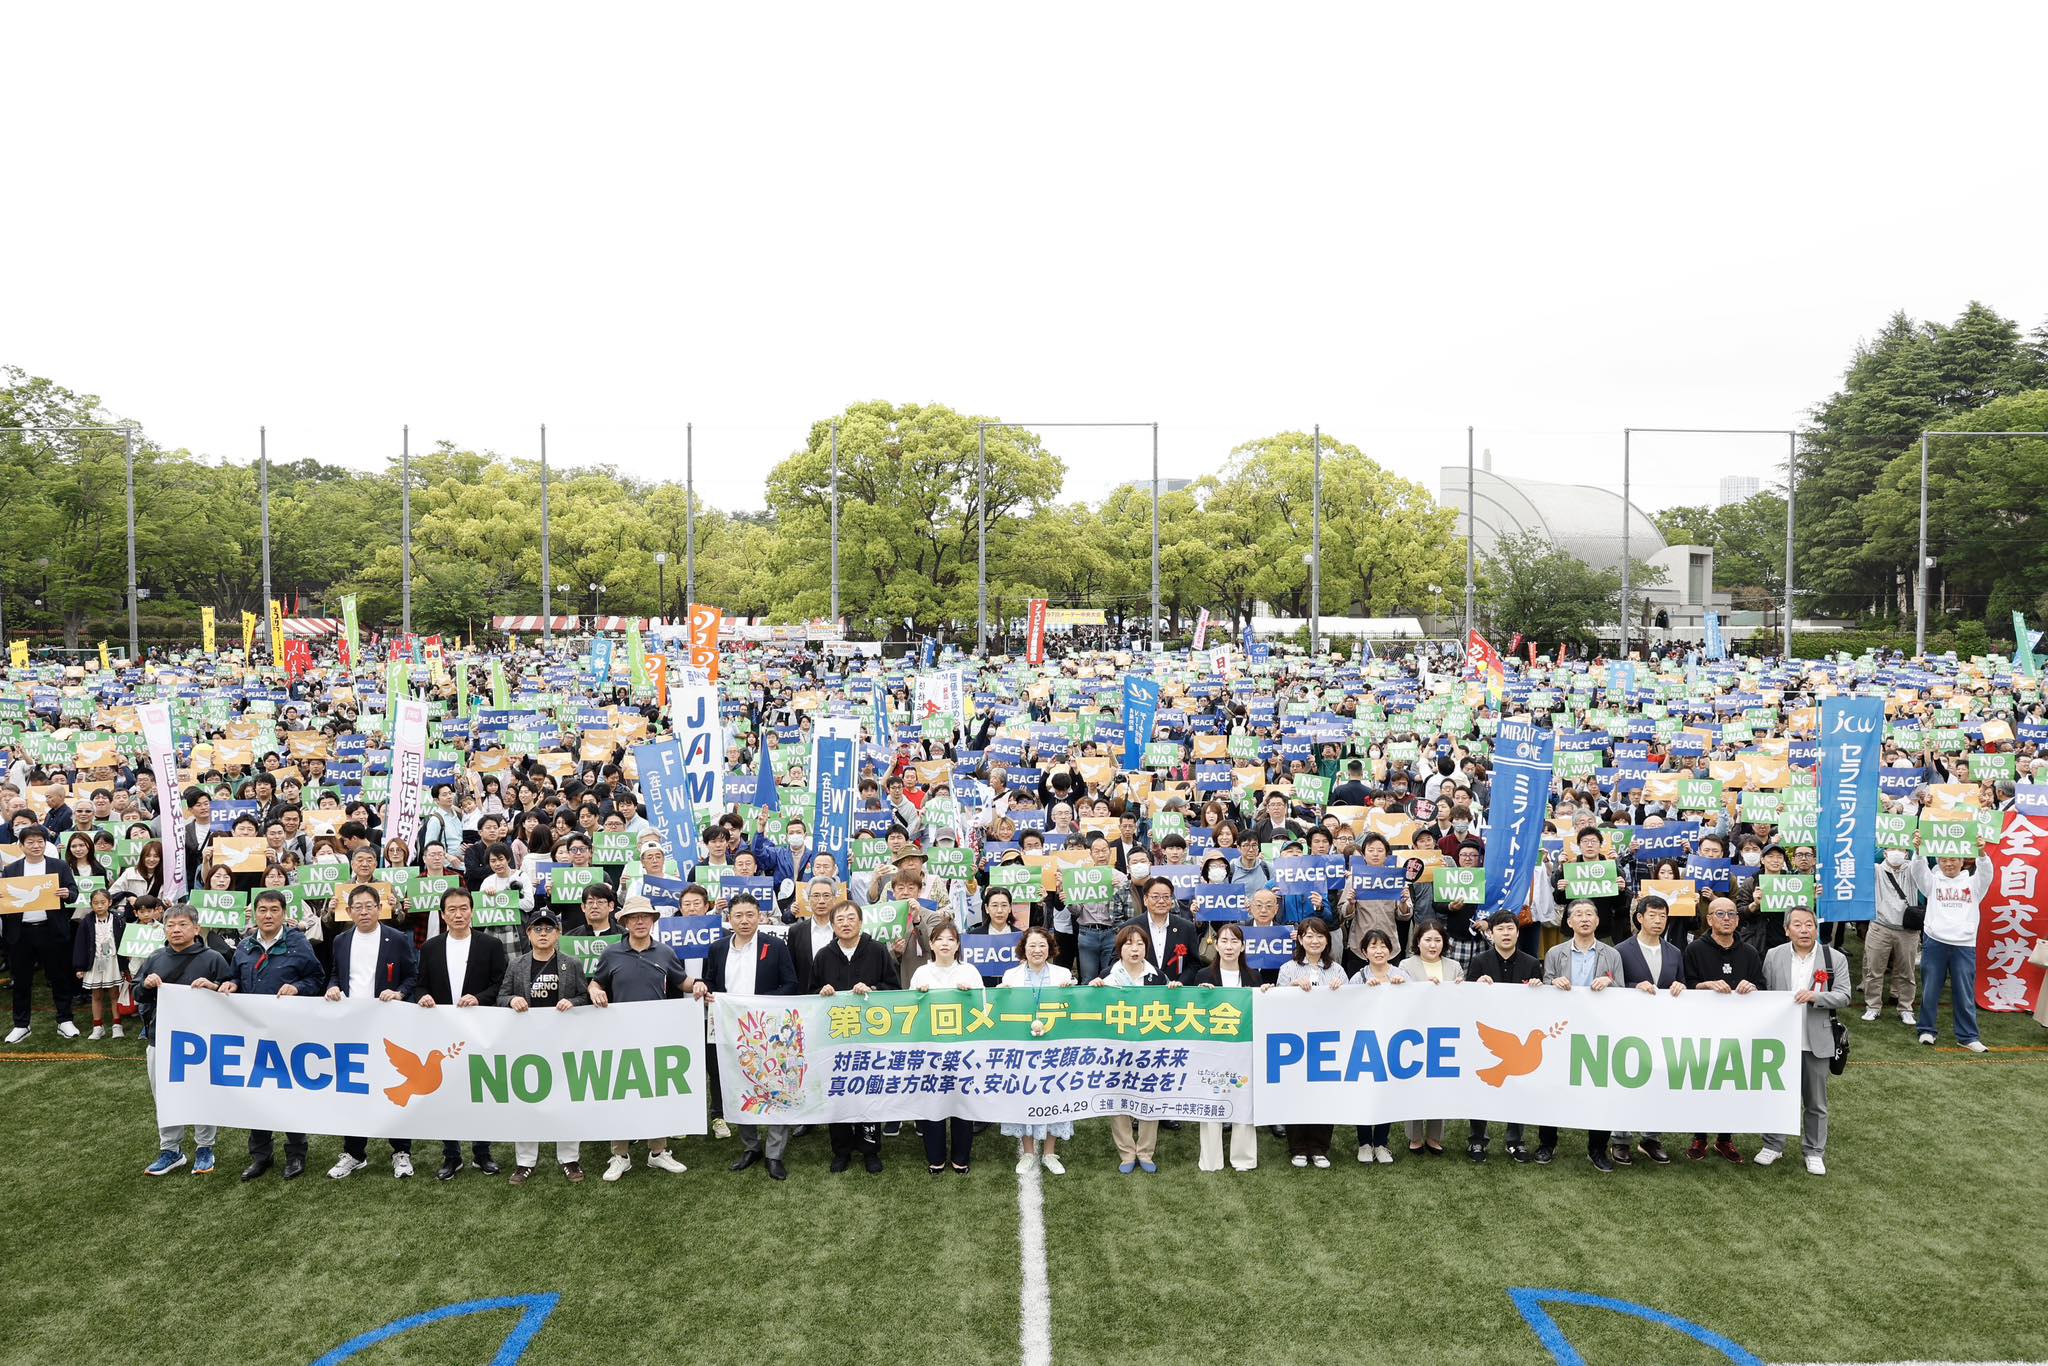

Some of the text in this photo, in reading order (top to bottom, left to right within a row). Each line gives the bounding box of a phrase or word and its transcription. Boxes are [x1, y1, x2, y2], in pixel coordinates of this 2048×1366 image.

[67, 701, 83, 709] NO
[479, 715, 507, 724] PEACE
[580, 715, 607, 724] PEACE
[1157, 712, 1182, 721] PEACE
[1191, 718, 1214, 727] PEACE
[1251, 714, 1273, 722] PEACE
[1751, 718, 1774, 727] WAR
[443, 723, 468, 733] PEACE
[929, 719, 944, 729] NO
[1390, 722, 1411, 731] WAR
[1629, 725, 1655, 734] PEACE
[1729, 723, 1745, 731] NO
[80, 733, 96, 741] NO
[514, 733, 532, 742] NO
[899, 731, 921, 739] PEACE
[926, 729, 948, 738] WAR
[1095, 726, 1124, 738] PEACE
[1318, 729, 1346, 738] PEACE
[1501, 722, 1536, 742] MIRAIT
[1725, 732, 1749, 740] WAR
[1901, 731, 1918, 740] NO
[1937, 731, 1958, 740] NO
[2017, 727, 2047, 738] PEACE
[109, 735, 129, 744] NO
[336, 739, 365, 749] PEACE
[1235, 737, 1252, 748] NO
[1465, 741, 1481, 750] NO
[1561, 741, 1590, 750] PEACE
[1671, 740, 1702, 749] PEACE
[1900, 741, 1920, 750] WAR
[1933, 740, 1960, 749] WAR
[48, 742, 68, 751] NO
[509, 743, 535, 752] WAR
[684, 696, 715, 804] JAM
[787, 745, 806, 755] NO
[992, 744, 1020, 756] PEACE
[1038, 742, 1067, 754] PEACE
[1152, 746, 1171, 754] NO
[1282, 743, 1311, 753] PEACE
[1516, 742, 1542, 761] ONE
[43, 753, 72, 762] WAR
[440, 752, 458, 761] NO
[1232, 748, 1256, 758] WAR
[1392, 749, 1416, 760] WAR
[1575, 752, 1594, 763] NO
[1616, 750, 1646, 759] PEACE
[1150, 755, 1175, 765] WAR
[1980, 755, 2005, 766] NO
[327, 769, 361, 780] PEACE
[423, 768, 452, 778] PEACE
[1007, 773, 1039, 784] PEACE
[1198, 772, 1231, 783] PEACE
[1974, 768, 2010, 780] WAR
[1301, 778, 1321, 790] NO
[1880, 774, 1921, 788] PEACE
[1688, 781, 1713, 794] NO
[790, 795, 809, 805] NO
[1295, 789, 1324, 801] WAR
[1682, 795, 1717, 808] WAR
[1753, 796, 1778, 808] NO
[855, 820, 891, 831] PEACE
[1160, 815, 1180, 826] NO
[1789, 812, 1817, 828] NO
[1833, 743, 1863, 900] セラミックス連合
[1876, 816, 1905, 831] NO
[1154, 828, 1185, 842] WAR
[1933, 823, 1965, 838] NO
[604, 835, 629, 848] NO
[863, 841, 887, 854] NO
[1638, 835, 1681, 849] PEACE
[1926, 840, 1972, 855] WAR
[599, 850, 634, 862] WAR
[939, 851, 963, 863] NO
[311, 867, 339, 881] NO
[381, 868, 408, 884] NO
[708, 868, 733, 880] NO
[931, 864, 967, 877] WAR
[1002, 869, 1031, 883] NO
[1074, 869, 1102, 884] NO
[1276, 868, 1325, 882] PEACE
[1577, 864, 1605, 879] NO
[1687, 865, 1730, 881] PEACE
[563, 870, 592, 884] NO
[1354, 876, 1402, 890] PEACE
[1447, 870, 1473, 885] NO
[419, 879, 448, 893] NO
[1571, 880, 1612, 896] WAR
[1773, 877, 1803, 892] NO
[722, 886, 774, 902] PEACE
[1069, 886, 1108, 901] WAR
[1439, 887, 1479, 901] WAR
[203, 893, 235, 909] NO
[482, 893, 509, 907] NO
[1199, 895, 1244, 909] PEACE
[1767, 895, 1808, 909] WAR
[198, 909, 240, 926] WAR
[476, 909, 516, 923] WAR
[865, 906, 896, 922] NO
[1984, 813, 2048, 1010] 全自交労連
[137, 924, 165, 941] NO
[661, 928, 720, 946] PEACE
[574, 940, 608, 955] NO
[827, 1002, 1242, 1039] 第97回メーデー中央大会
[832, 1045, 1190, 1072] 対話と連帯で築く、平和で笑顔あふれる未来
[1266, 1027, 1460, 1083] PEACE
[169, 1030, 370, 1095] PEACE
[1568, 1033, 1786, 1090] NO WAR
[469, 1044, 692, 1103] NO WAR
[828, 1070, 1188, 1097] 真の働き方改革で、安心してくらせる社会を！
[1028, 1101, 1089, 1117] 2026.4.29
[1099, 1098, 1225, 1117] 主催 第97回メーデー中央実行委員会
